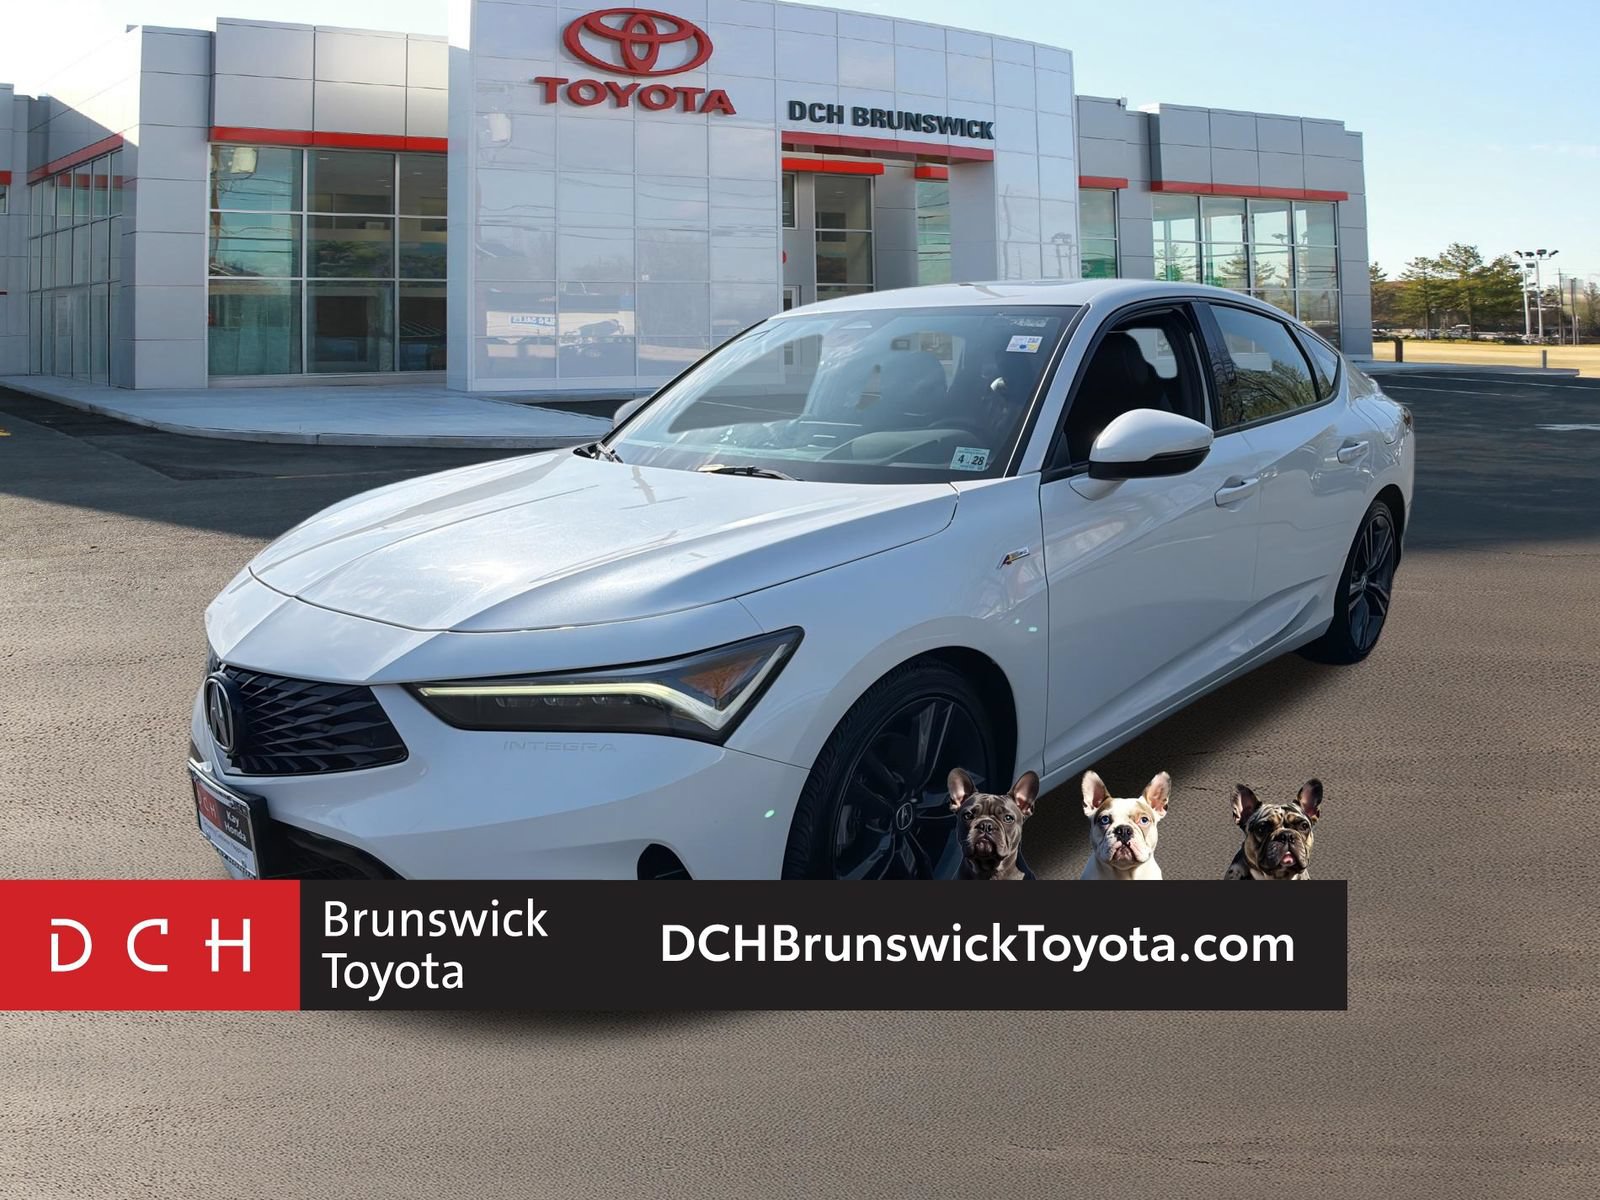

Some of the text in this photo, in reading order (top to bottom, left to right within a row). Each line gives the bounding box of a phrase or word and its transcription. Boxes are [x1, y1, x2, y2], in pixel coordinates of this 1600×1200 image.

[534, 76, 736, 115] TOYOTA
[788, 100, 994, 140] DCH BRUNSWICK
[958, 454, 984, 466] 4 28
[503, 741, 617, 753] INTEGRA
